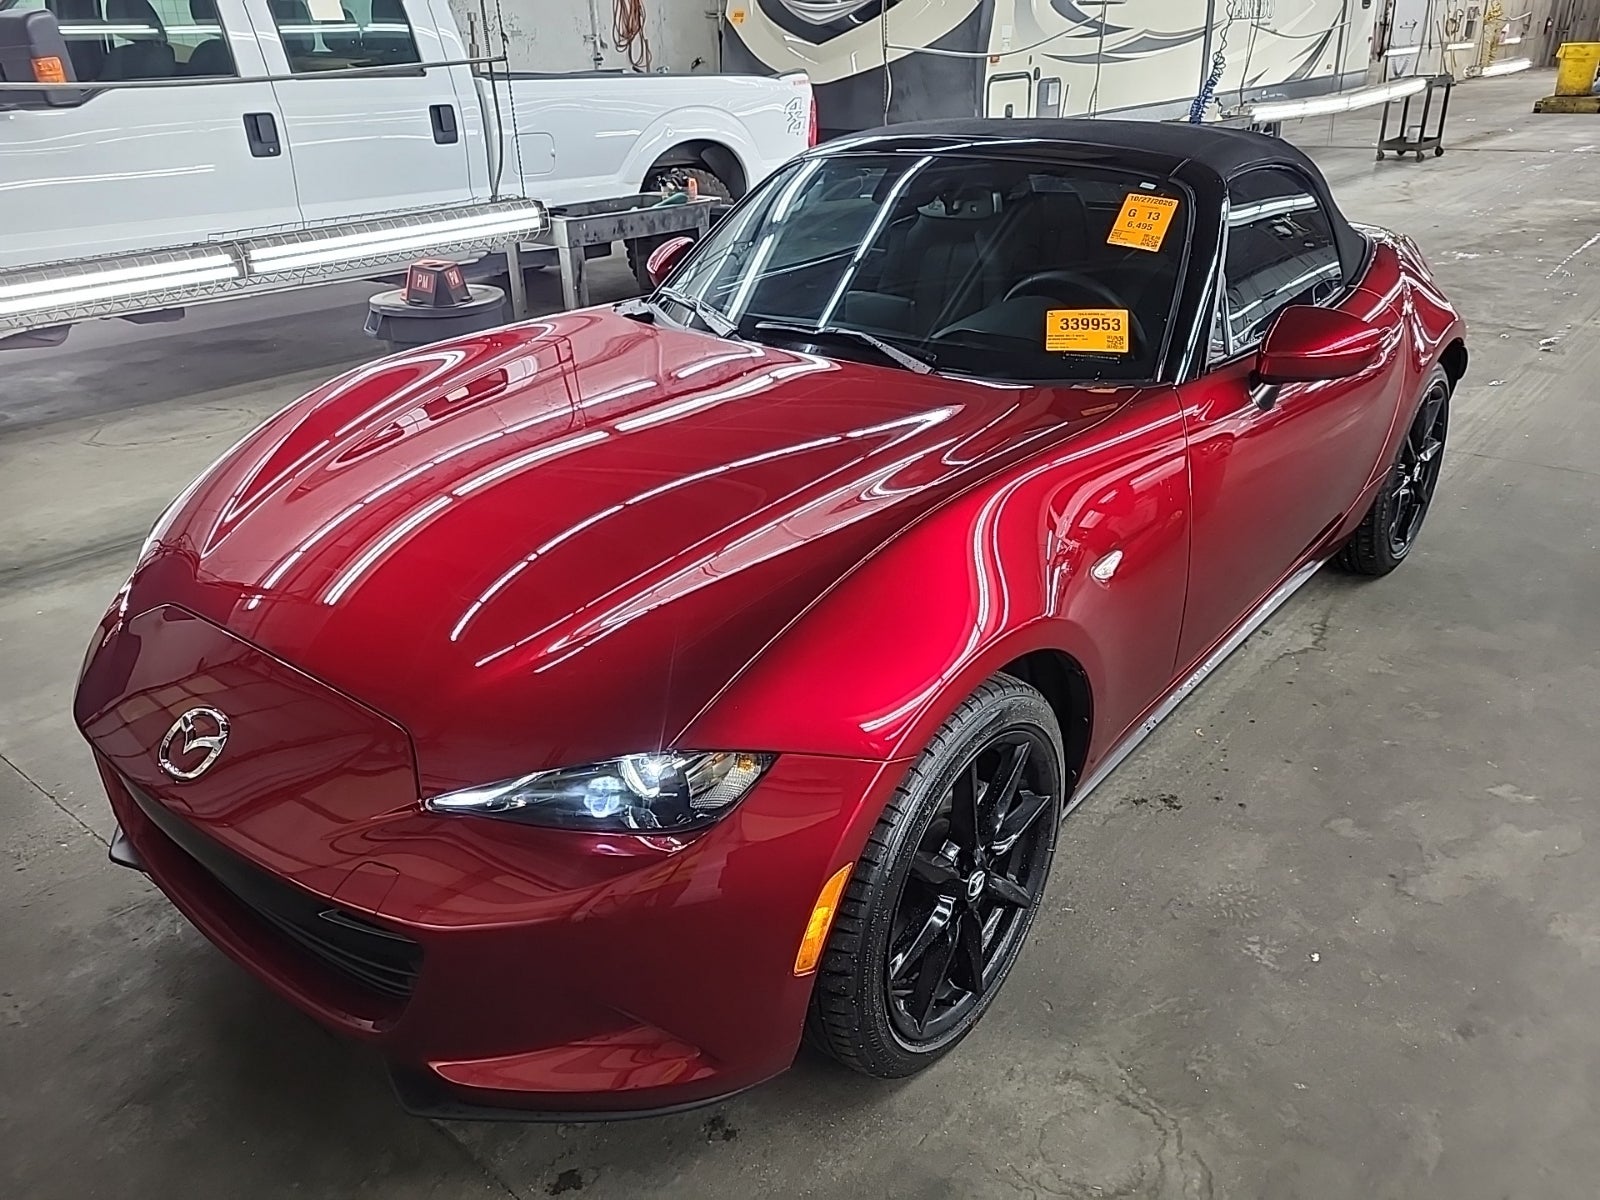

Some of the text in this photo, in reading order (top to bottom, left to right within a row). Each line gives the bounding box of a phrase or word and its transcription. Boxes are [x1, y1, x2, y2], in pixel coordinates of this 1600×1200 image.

[1128, 208, 1161, 221] G 13
[1060, 317, 1121, 331] 339953
